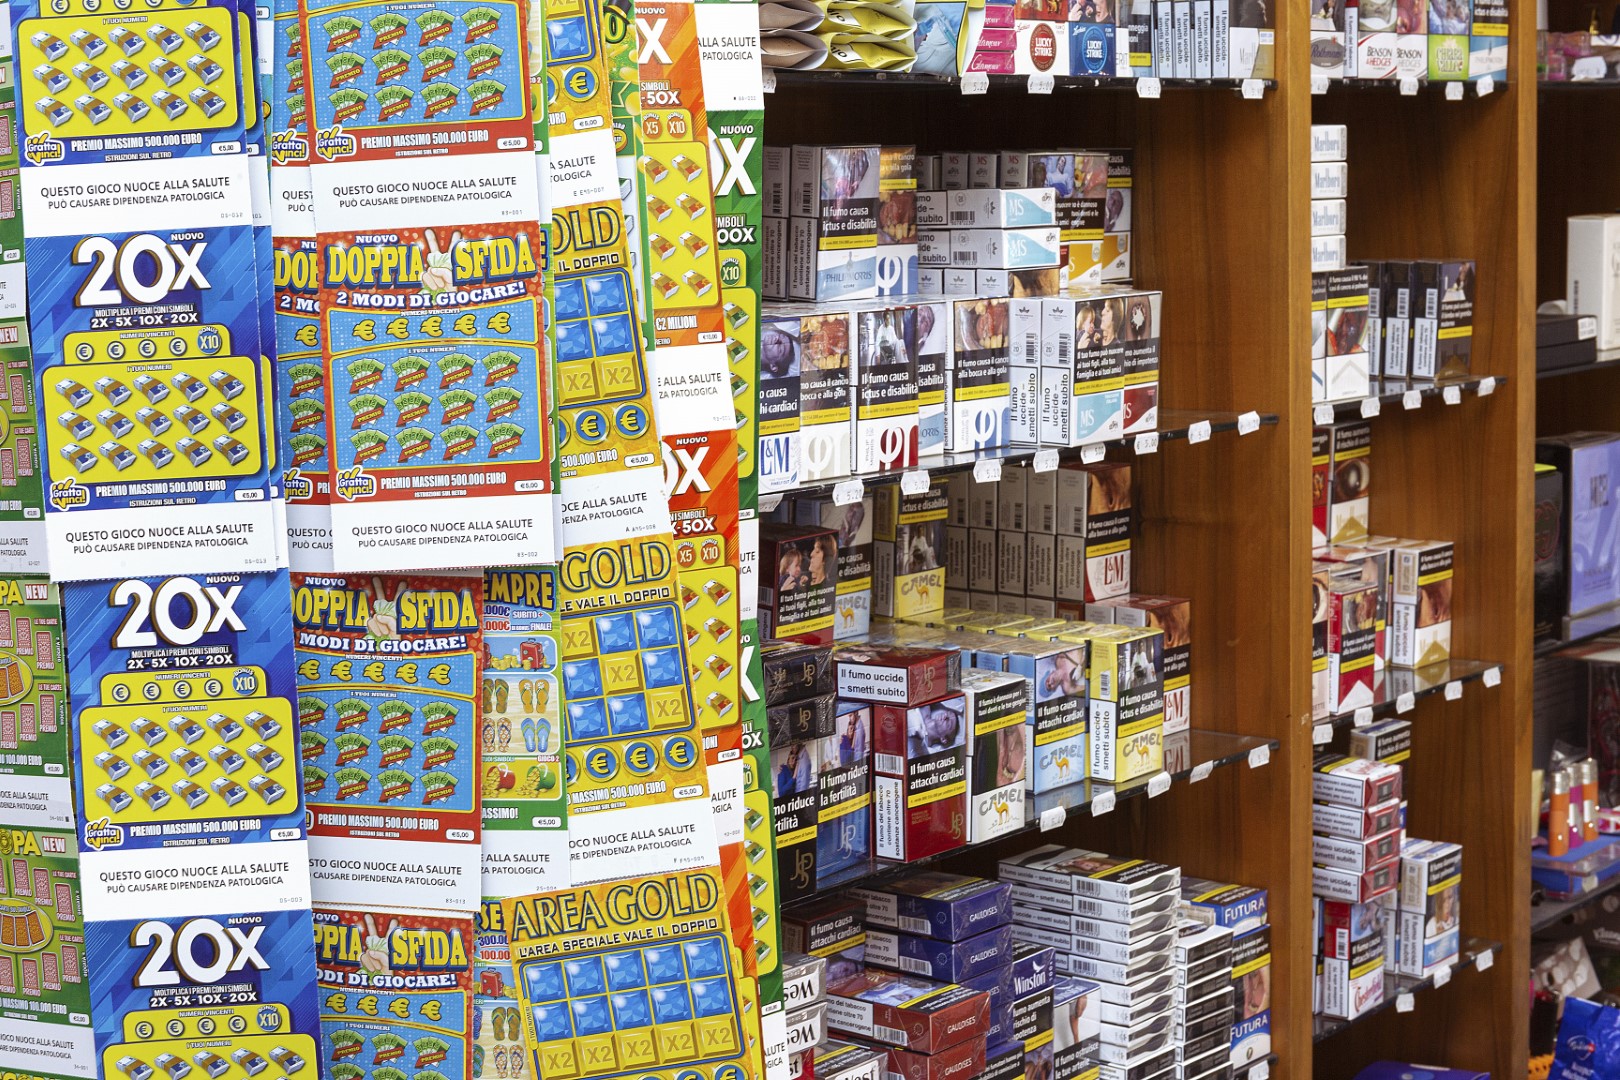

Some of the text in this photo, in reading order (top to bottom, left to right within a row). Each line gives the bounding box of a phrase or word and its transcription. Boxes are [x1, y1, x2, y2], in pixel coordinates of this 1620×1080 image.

[1034, 46, 1052, 56] STRIKE
[1036, 38, 1052, 48] LUCKY
[1087, 41, 1102, 50] LUCKY
[1367, 46, 1392, 56] BENSON
[703, 52, 753, 60] PATOLOGICA
[1087, 49, 1102, 58] STRIKE
[1397, 48, 1421, 58] BENSON
[641, 82, 669, 90] SIMBOLI
[646, 122, 685, 133] X5 X10
[720, 126, 753, 134] NUOVO
[71, 132, 202, 152] PREMIO MASSIMO 500.000 EURO
[361, 130, 488, 149] PREMIO MASSIMO 500.000 EURO
[41, 176, 230, 198] QUESTO GIOCO NUOCE ALLA SALUTE
[48, 190, 224, 210] PUÒ CAUSARE DIPENDENZA PATOLOGICA
[339, 190, 512, 208] PUÒ CAUSARE DIPENDENZA PATOLOGICA
[830, 206, 868, 216] fumo causa
[1009, 200, 1024, 216] MS
[823, 218, 877, 231] ictus e disabilità
[171, 232, 204, 242] NUOVO
[356, 234, 397, 244] NUOVO
[327, 234, 536, 284] DOPPIA SFIDA
[72, 234, 211, 306] 20X
[337, 281, 525, 308] 2 MODI DI GIOCARE!
[668, 316, 697, 329] MILIONI
[200, 336, 219, 350] X10
[664, 373, 722, 385] ALLA SALUTE
[869, 372, 908, 384] fumo causa
[766, 388, 787, 398] causa
[862, 384, 918, 399] ictus e disabilità
[769, 399, 797, 413] cardiaci
[1081, 409, 1094, 427] MS
[676, 436, 708, 444] NUOVO
[761, 437, 789, 475] L&M
[96, 480, 226, 497] PREMIO MASSIMO 500.000 EURO
[66, 523, 254, 543] QUESTO GIOCO NUOCE ALLA SALUTE
[561, 541, 671, 592] GOLD
[1104, 555, 1124, 586] L&M
[206, 575, 240, 584] NUOVO
[305, 576, 346, 586] NUOVO
[901, 574, 942, 596] CAMEL
[110, 576, 247, 649] 20X
[401, 590, 478, 629] SFIDA
[848, 669, 904, 683] fumo uccide
[847, 684, 905, 697] smetti subito
[1126, 689, 1157, 704] fumo causa
[1044, 700, 1077, 715] fumo causa
[1038, 708, 1084, 730] attacchi cardiaci
[1123, 733, 1161, 757] CAMEL
[1039, 744, 1083, 769] CAMEL
[917, 755, 956, 775] fumo causa
[828, 764, 868, 788] fumo riduce
[910, 765, 965, 790] attacchi cardiaci
[828, 783, 857, 805] fertilità
[787, 795, 815, 812] riduce
[979, 789, 1023, 816] CAMEL
[595, 824, 696, 846] NUOCE ALLA SALUTE
[43, 837, 66, 852] NEW
[330, 859, 462, 875] GIOCO NUOCE ALLA SALUTE
[512, 873, 719, 941] AREA GOLD
[969, 907, 997, 922] GAULOISES
[1224, 897, 1265, 924] FUTURA
[835, 916, 853, 930] causa
[563, 918, 718, 951] SPECIALE VALE IL DOPPIO
[811, 933, 836, 949] attacchi
[130, 918, 270, 988] 20X
[393, 930, 467, 966] SFIDA
[970, 948, 998, 964] GAULOISES
[1013, 970, 1046, 996] Winston
[947, 1016, 976, 1034] GAULOISES
[1230, 1016, 1268, 1040] FUTURA
[16, 1036, 35, 1044] NUOCE
[52, 1040, 74, 1049] SALUTE
